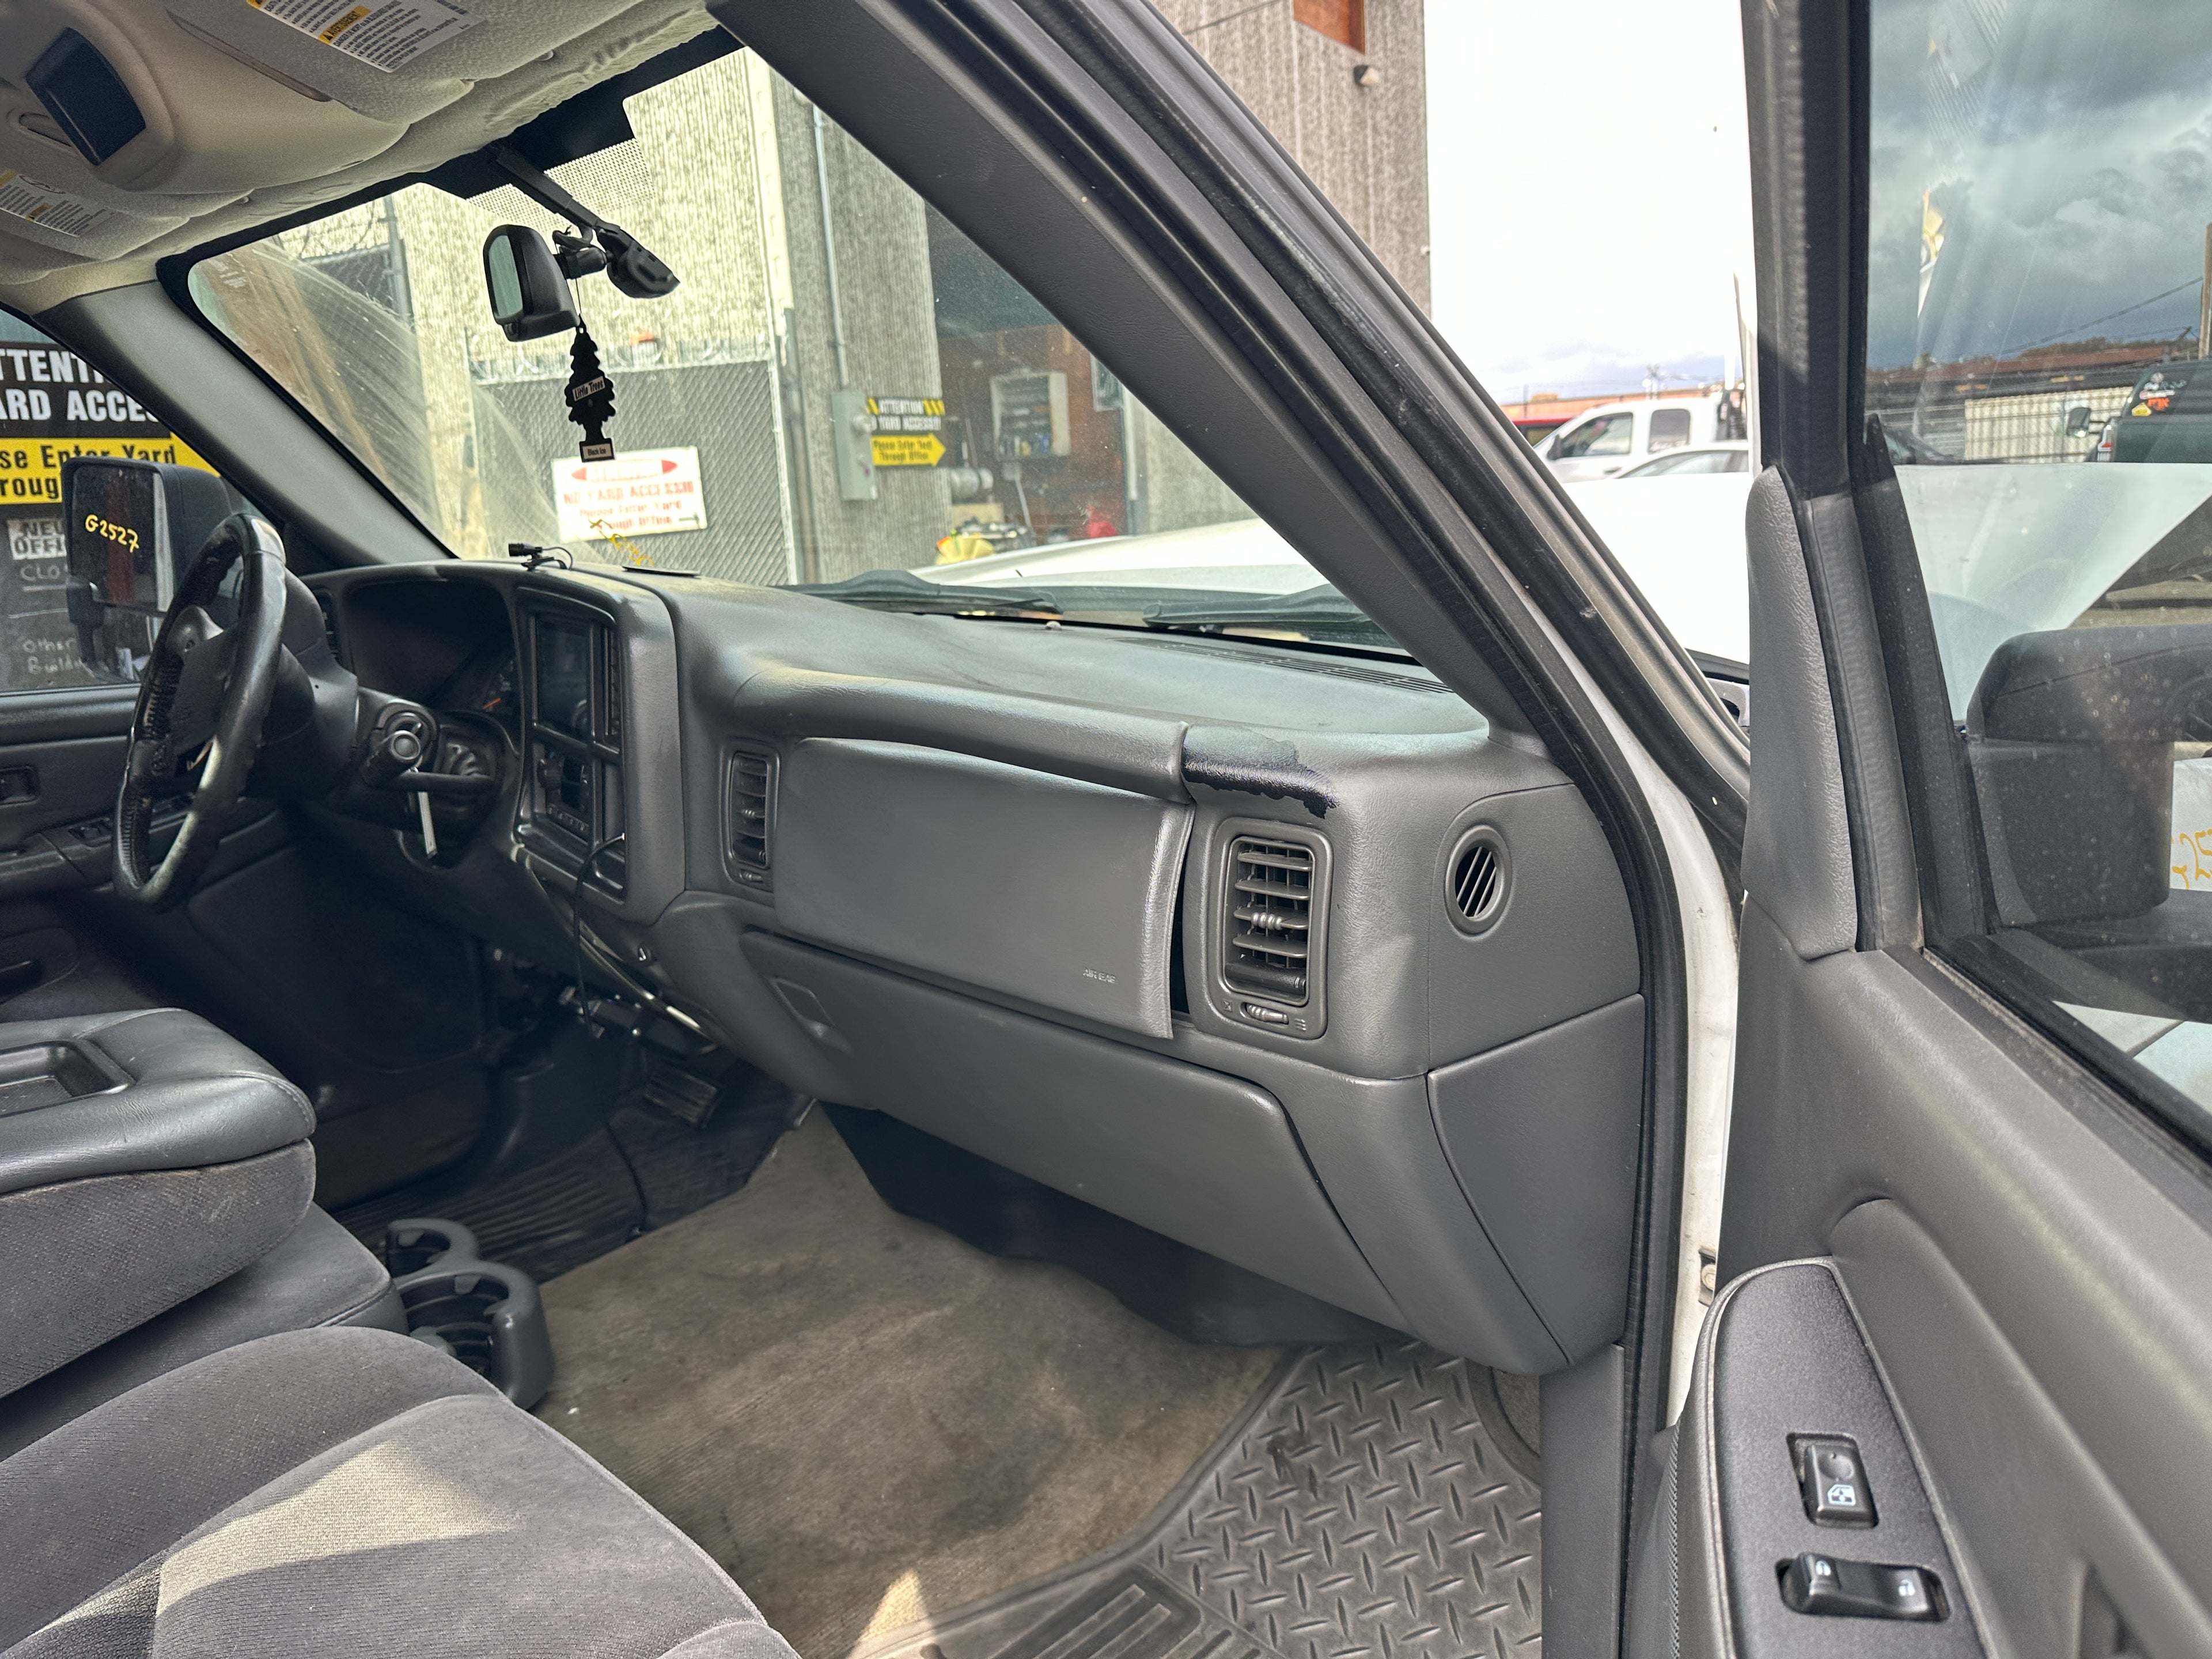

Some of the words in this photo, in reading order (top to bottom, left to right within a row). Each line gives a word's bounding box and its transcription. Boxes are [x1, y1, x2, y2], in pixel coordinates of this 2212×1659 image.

[574, 385, 589, 400] Little
[589, 380, 604, 393] Trees
[85, 514, 139, 553] G2527
